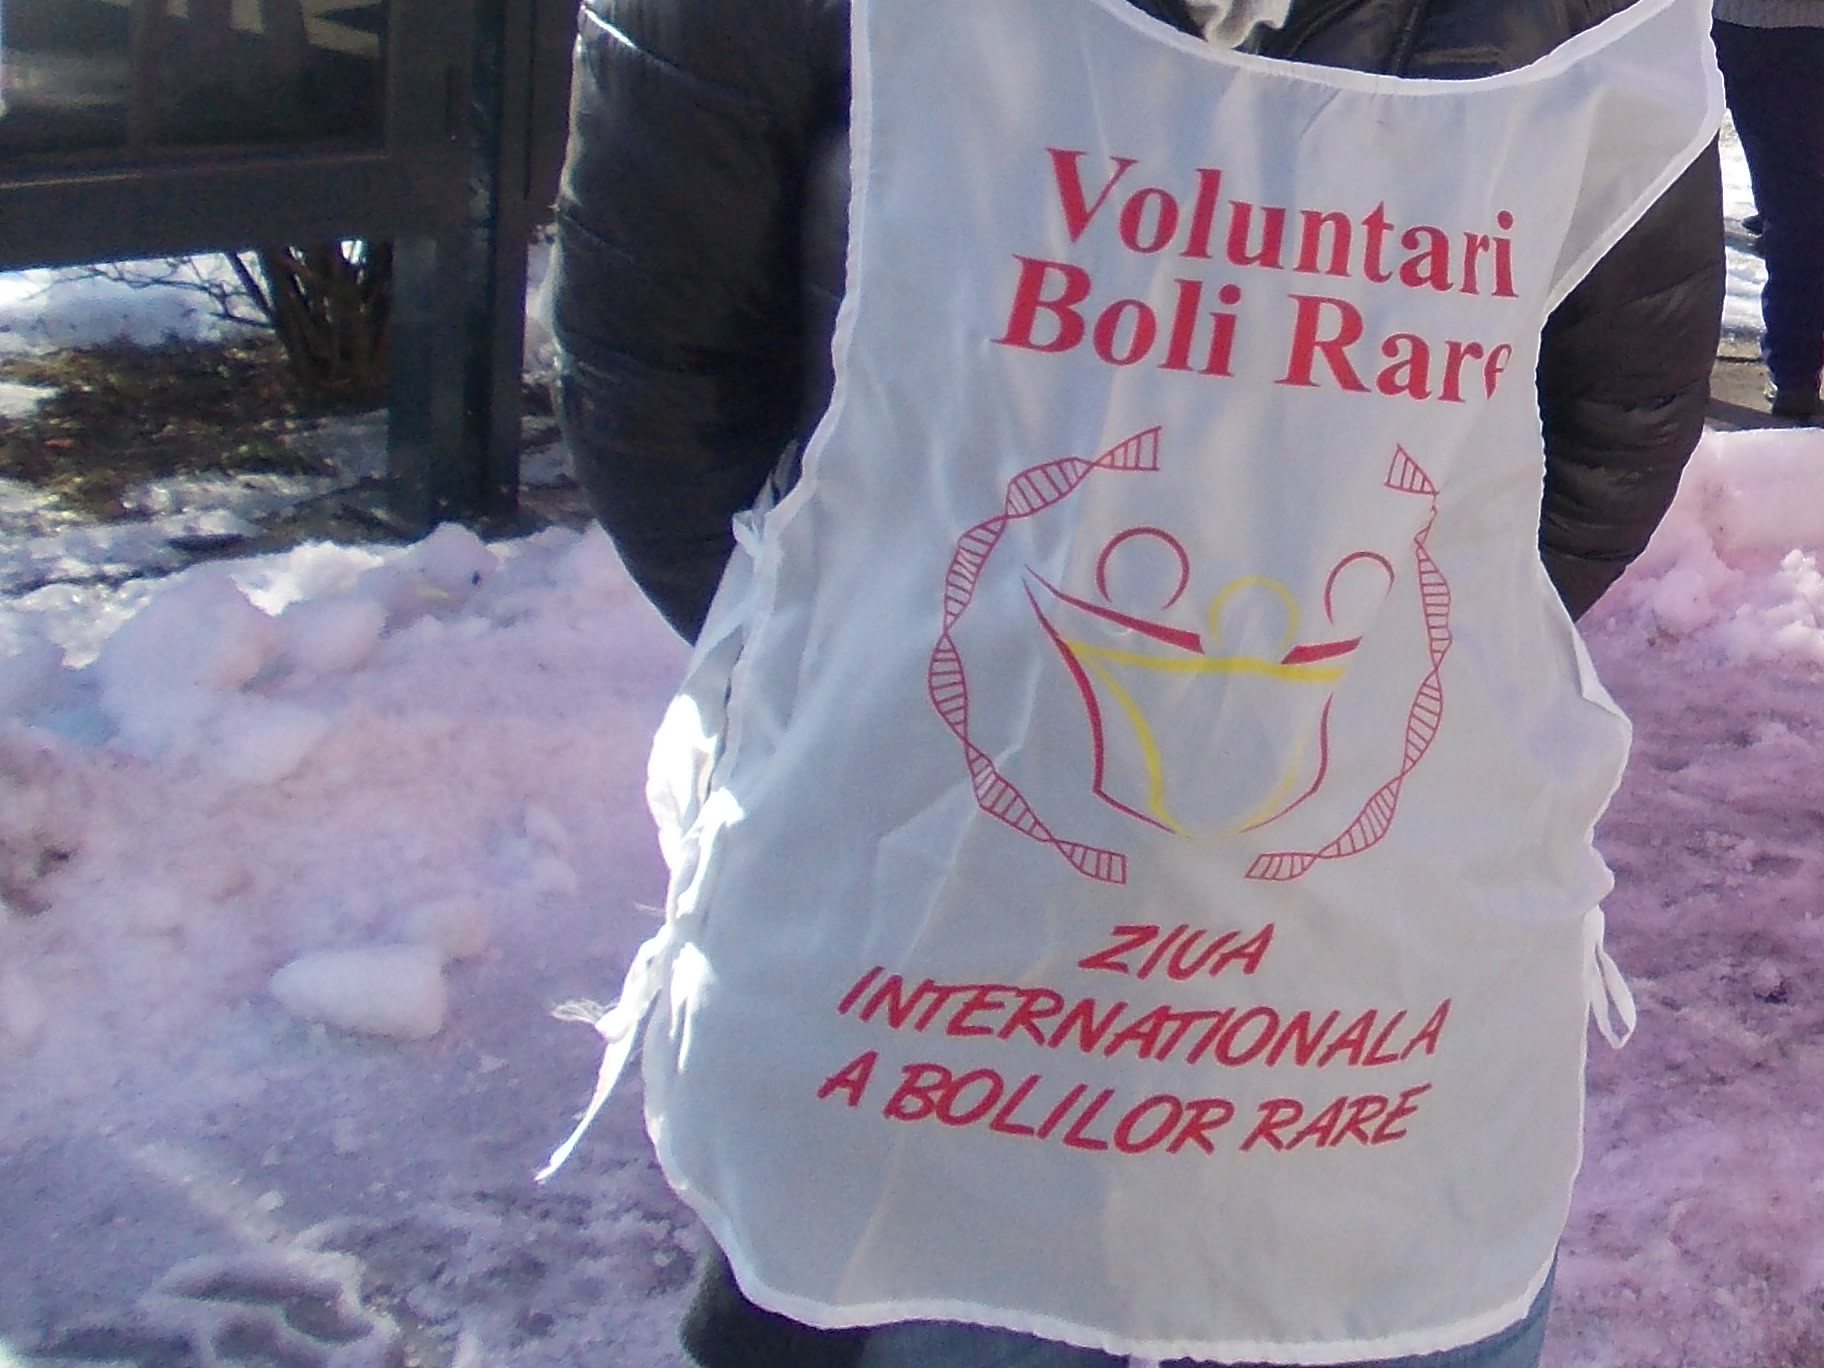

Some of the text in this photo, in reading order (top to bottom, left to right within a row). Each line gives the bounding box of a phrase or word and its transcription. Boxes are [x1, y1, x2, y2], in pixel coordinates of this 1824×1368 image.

[1044, 146, 1520, 299] Voluntari
[990, 253, 1242, 378] Boli
[1077, 922, 1276, 982] ZIUA
[836, 965, 1453, 1069] INTERNATIONALA
[816, 1050, 1434, 1157] A BOLILOR RARE
